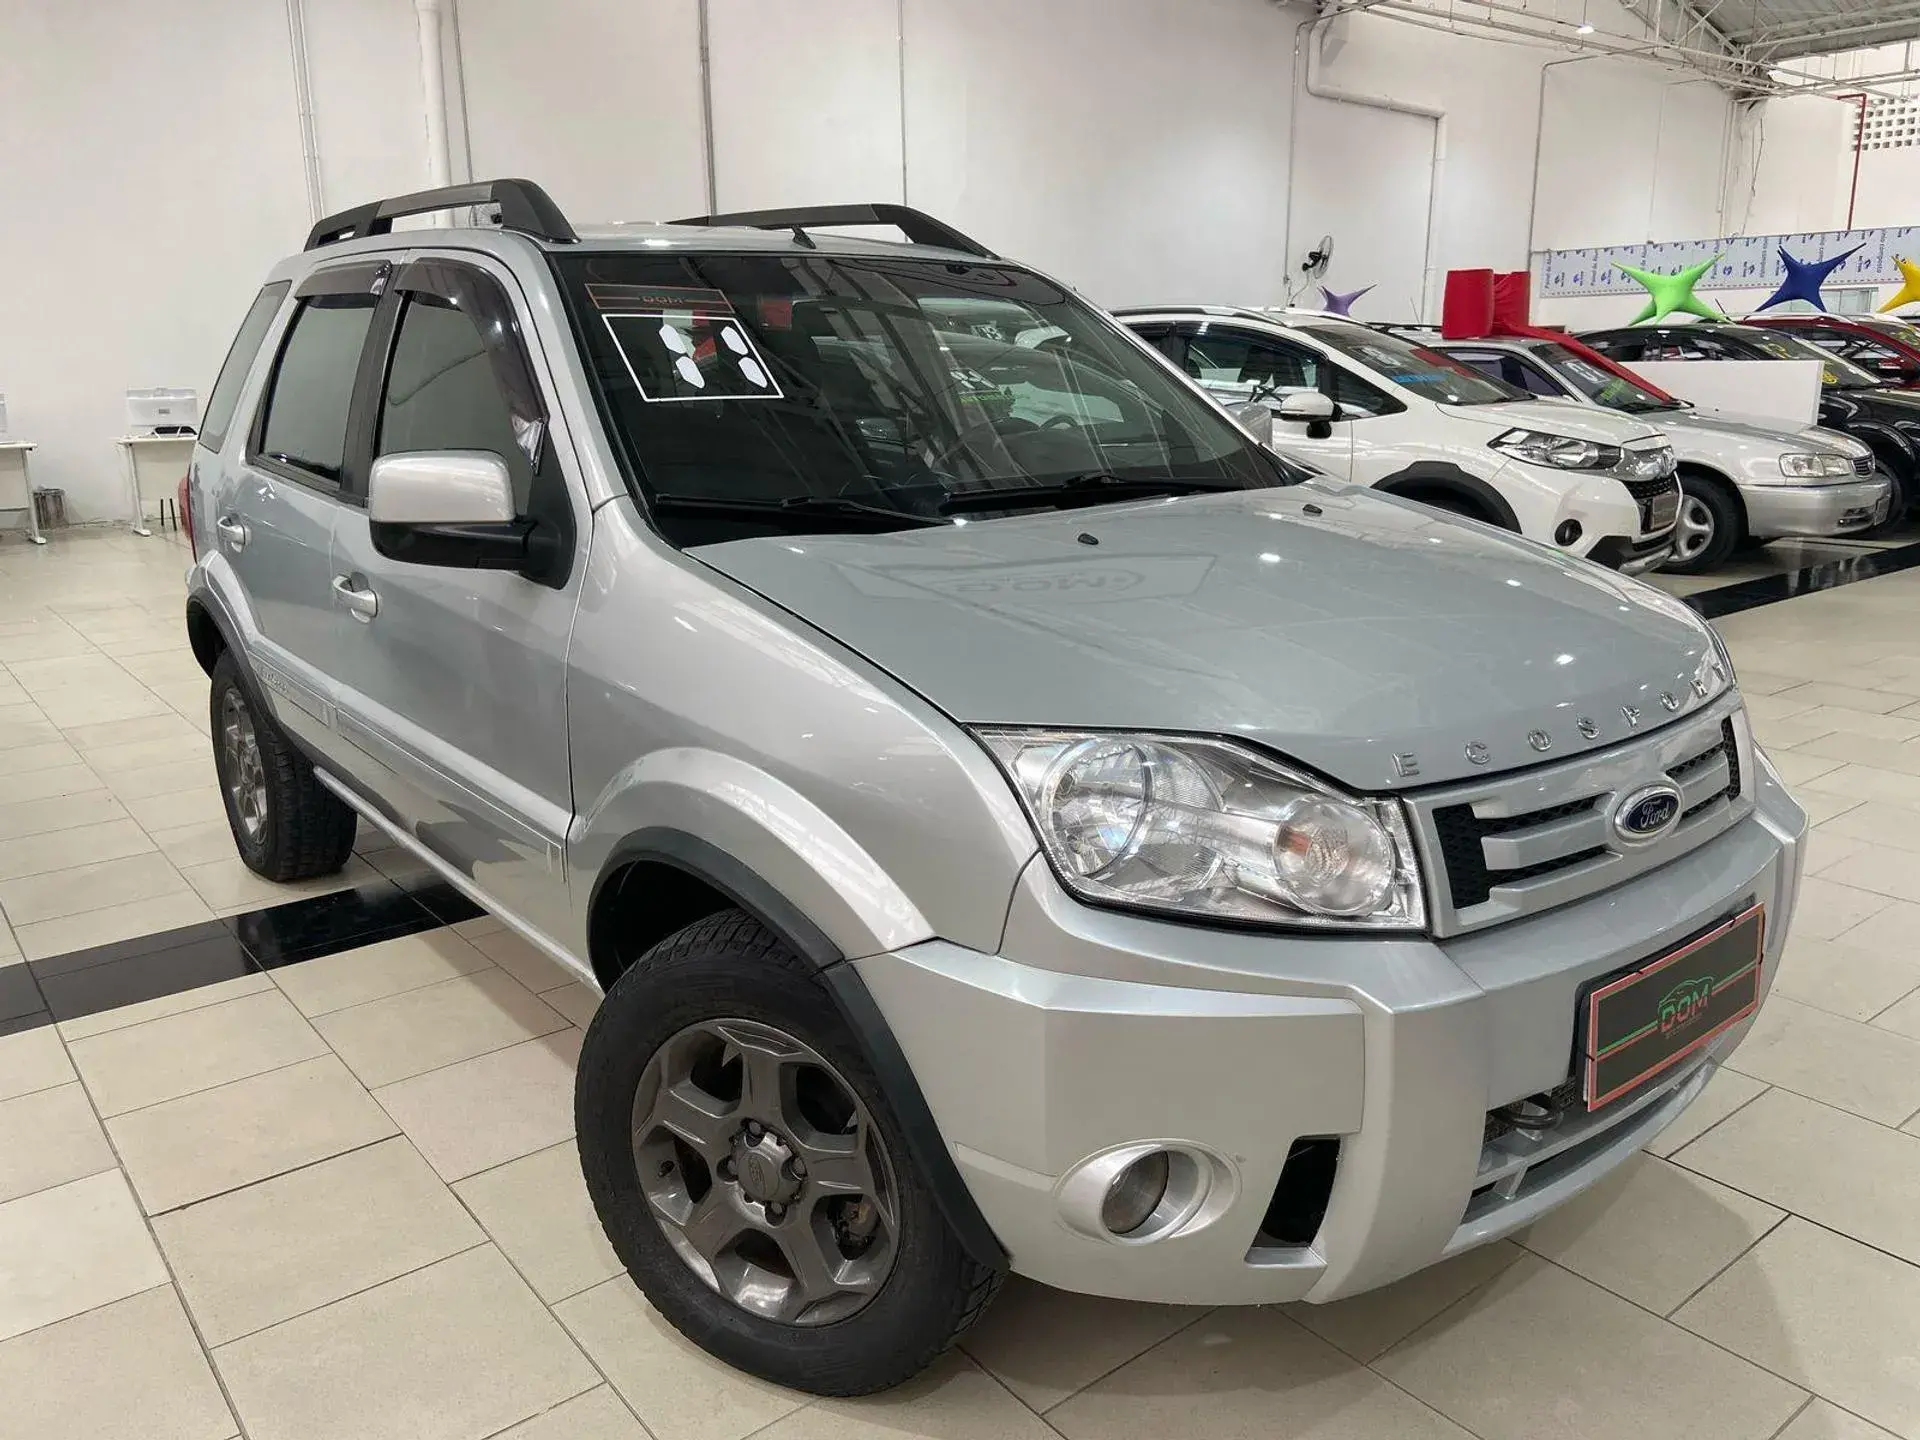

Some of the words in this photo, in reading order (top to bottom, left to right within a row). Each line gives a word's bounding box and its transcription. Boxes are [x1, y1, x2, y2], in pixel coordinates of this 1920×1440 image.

[1391, 661, 1726, 778] ECOSPORT
[1640, 797, 1672, 828] Ford
[1660, 983, 1709, 1033] DOM
